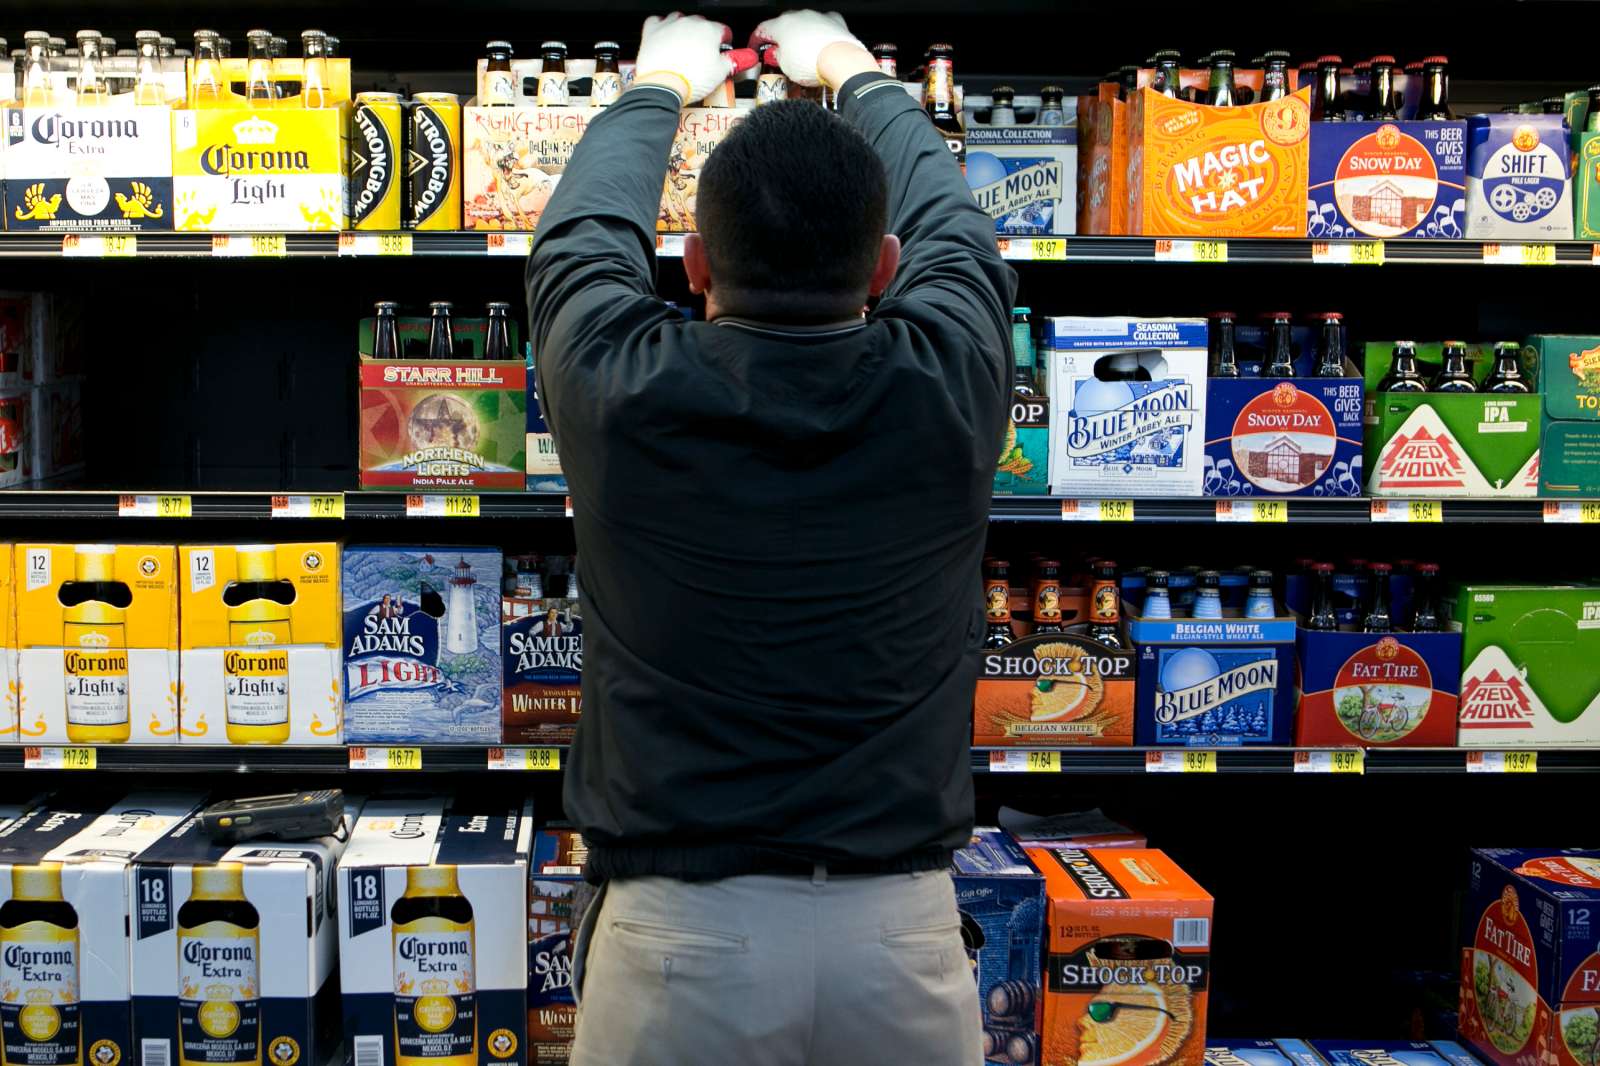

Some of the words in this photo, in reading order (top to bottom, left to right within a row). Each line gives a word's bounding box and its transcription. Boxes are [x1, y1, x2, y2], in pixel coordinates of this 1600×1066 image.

[31, 113, 139, 148] Corona
[966, 130, 1002, 139] EASONAL
[1003, 129, 1052, 139] COLLECTION
[1424, 129, 1439, 139] THIS
[1440, 127, 1463, 141] BEER
[69, 141, 105, 155] Extra
[1436, 141, 1464, 156] GIVES
[201, 143, 310, 179] Corona
[354, 109, 386, 216] STRONGBOW
[414, 109, 448, 221] STRONGBOW
[1173, 139, 1271, 193] MAGIC
[1350, 156, 1393, 170] SNOW
[1394, 156, 1422, 170] DAY
[1444, 155, 1462, 165] BACK
[1501, 154, 1548, 174] SHIFT
[978, 186, 1000, 209] UE
[1006, 167, 1057, 199] MOON
[1511, 176, 1524, 185] PALE
[1524, 176, 1540, 185] LAGER
[231, 178, 286, 204] Light
[1009, 193, 1033, 207] ABBEY
[1035, 189, 1050, 197] ALE
[1190, 177, 1265, 214] HAT
[104, 236, 126, 252] $8.47
[252, 235, 279, 253] $16.64
[380, 235, 402, 253] $9.88
[1036, 241, 1057, 258] $8.97
[1198, 243, 1219, 260] $8.28
[1354, 244, 1375, 260] $9.64
[1526, 243, 1546, 261] $7.28
[1133, 331, 1180, 340] COLLECTION
[1136, 322, 1178, 332] SEASONAL
[1064, 357, 1074, 365] 12
[384, 366, 452, 383] STARR
[455, 367, 504, 384] HILL
[1323, 387, 1338, 396] THIS
[1339, 385, 1360, 398] BEER
[1011, 403, 1044, 422] OP
[1334, 398, 1361, 413] GIVES
[1484, 406, 1510, 422] IPA
[1068, 412, 1127, 449] BLUE
[1133, 390, 1188, 426] MOON
[1248, 412, 1291, 427] SNOW
[1292, 412, 1322, 427] DAY
[1343, 412, 1360, 422] BACK
[1100, 432, 1132, 450] WINTER
[1136, 420, 1161, 434] ABBEY
[1164, 415, 1180, 425] ALE
[402, 448, 485, 472] NORTHERN
[1400, 446, 1443, 459] RED
[417, 464, 470, 477] LIGHTS
[1389, 462, 1454, 477] HOOK
[412, 478, 434, 486] INDIA
[436, 478, 456, 486] PALE
[458, 478, 475, 486] ALE
[161, 497, 182, 513] $8.77
[314, 497, 334, 513] $7.47
[446, 496, 473, 513] $11.28
[1101, 502, 1126, 518] $15.97
[1258, 503, 1279, 519] $8.47
[1413, 504, 1433, 520] $6.64
[32, 555, 46, 570] 12
[196, 556, 209, 571] 12
[364, 614, 410, 636] SAM
[1176, 623, 1222, 634] BELGIAN
[1225, 624, 1260, 633] WHITE
[348, 634, 425, 658] ADAMS
[65, 652, 126, 676] Corona
[225, 652, 286, 676] Corona
[515, 652, 582, 674] ADAMS
[985, 655, 1074, 676] SHOCK
[1080, 655, 1130, 676] TOP
[1352, 662, 1380, 678] FAT
[1382, 663, 1419, 678] TIRE
[359, 660, 441, 689] LIGHT
[77, 677, 115, 697] Light
[237, 677, 275, 697] Light
[1155, 685, 1214, 724] BLUE
[1218, 664, 1274, 700] MOON
[1472, 688, 1514, 701] RED
[512, 694, 566, 713] WINTER
[1460, 704, 1522, 719] HOOK
[1015, 724, 1057, 732] BELGIAN
[1060, 724, 1093, 732] WHITE
[64, 749, 89, 765] $17.28
[388, 750, 414, 766] $16.77
[529, 750, 550, 766] $8.88
[1030, 752, 1051, 769] $7.64
[1186, 752, 1208, 769] $8.97
[1334, 753, 1356, 770] $8.97
[1504, 754, 1530, 769] $13.97
[1472, 861, 1482, 879] 12
[354, 874, 377, 900] 18
[1071, 864, 1122, 898] SHOCK
[142, 878, 164, 902] 18
[142, 908, 167, 916] BOTTLES
[1568, 908, 1590, 925] 12
[1060, 926, 1073, 938] 12
[400, 936, 468, 962] Corona
[1484, 916, 1505, 949] FAT
[1504, 934, 1532, 968] TIRE
[4, 944, 73, 970] Corona
[184, 940, 252, 966] Corona
[202, 963, 242, 978] Extra
[418, 958, 458, 973] Extra
[1062, 964, 1146, 984] SHOCK
[1154, 964, 1202, 984] TOP
[23, 967, 62, 982] Extra
